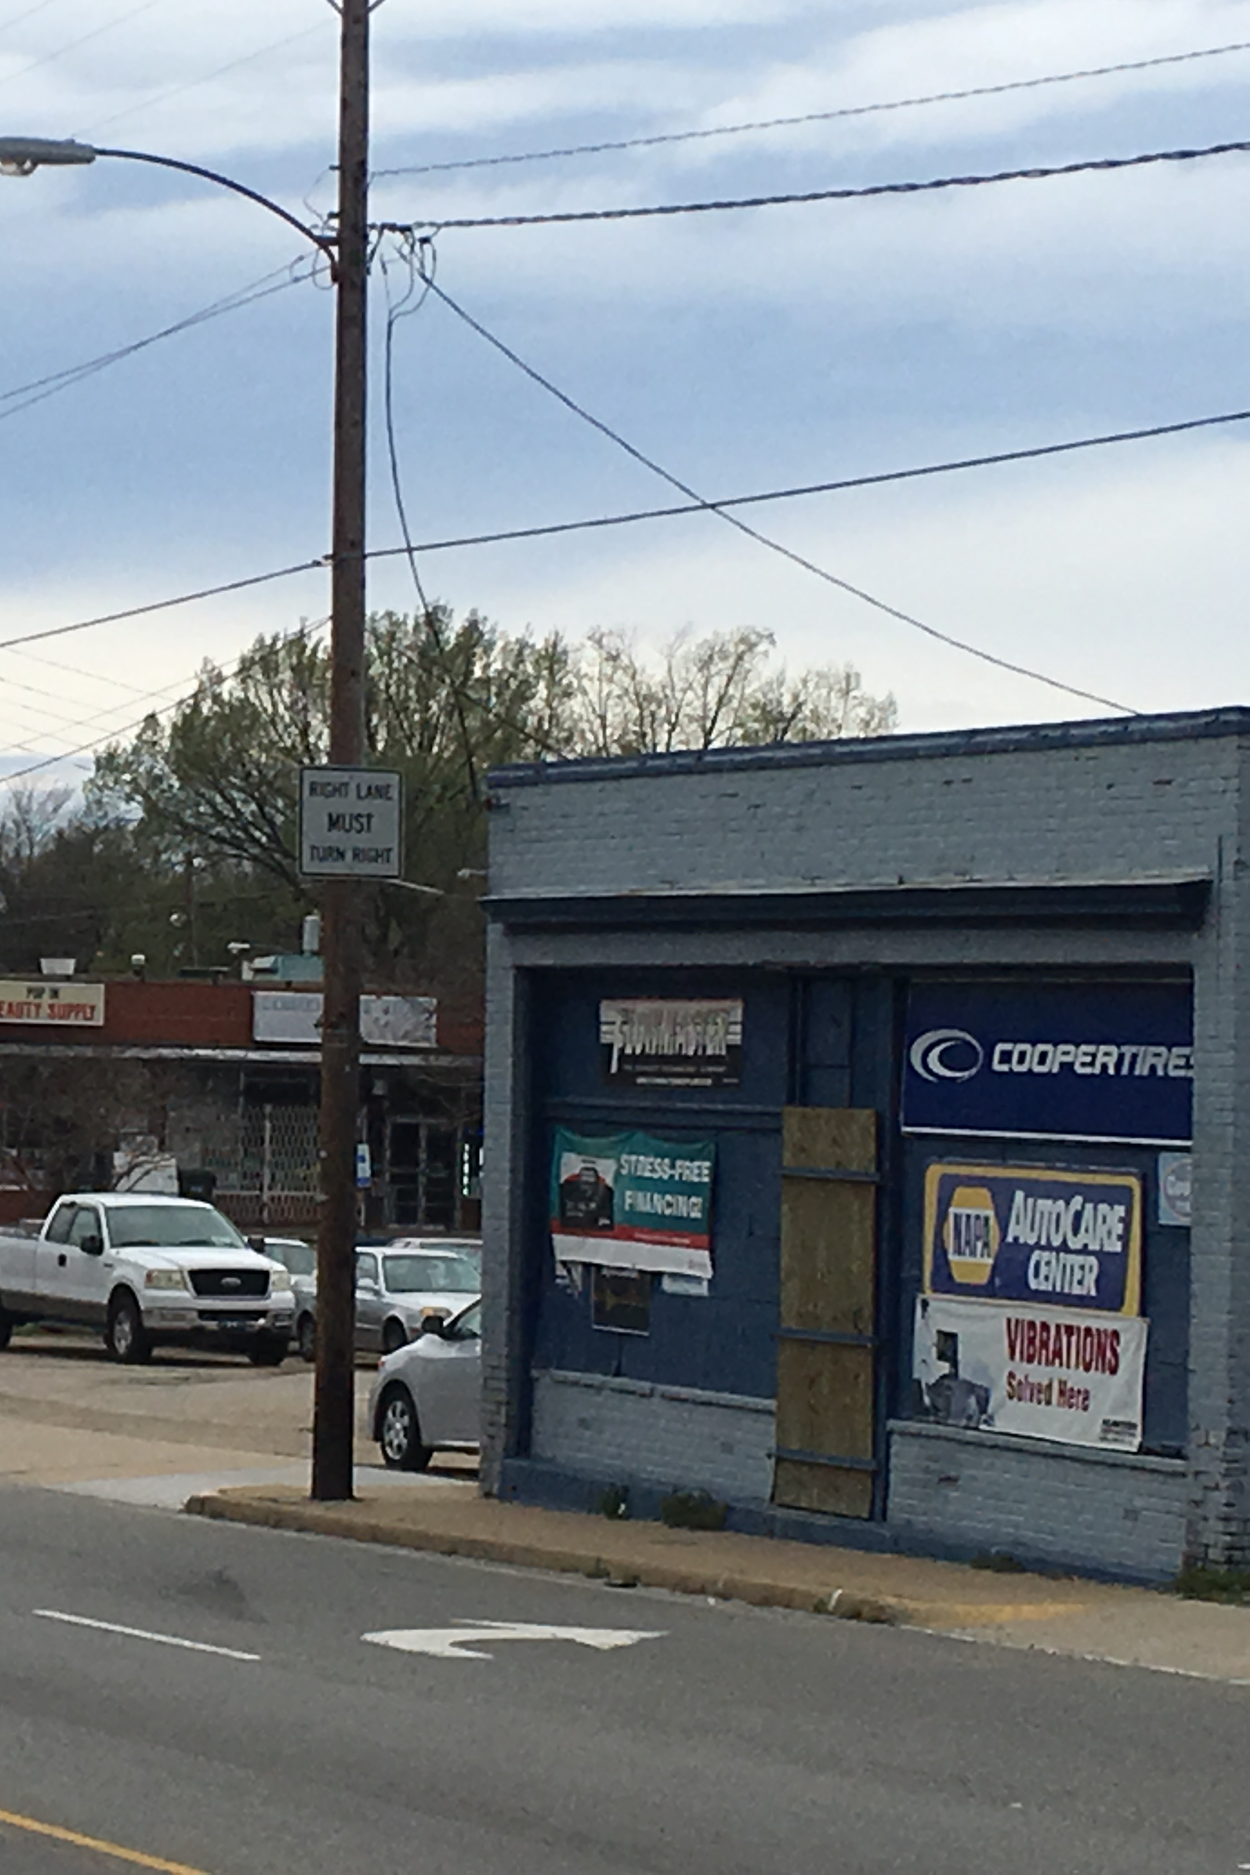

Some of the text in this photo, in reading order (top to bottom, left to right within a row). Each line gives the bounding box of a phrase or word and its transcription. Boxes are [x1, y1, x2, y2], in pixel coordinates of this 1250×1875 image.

[310, 781, 393, 800] RIGHT LANE
[327, 812, 374, 833] MUST
[310, 845, 393, 863] TURN RIGHT
[47, 1003, 96, 1020] SUPPLY
[620, 1153, 711, 1182] STRESS-FREE
[624, 1190, 703, 1218] FINANCING
[952, 1212, 992, 1259] NAPA
[1027, 1250, 1099, 1296] CENTER
[1006, 1317, 1120, 1376] VIBRATIONS
[1006, 1370, 1090, 1412] Solved Here
